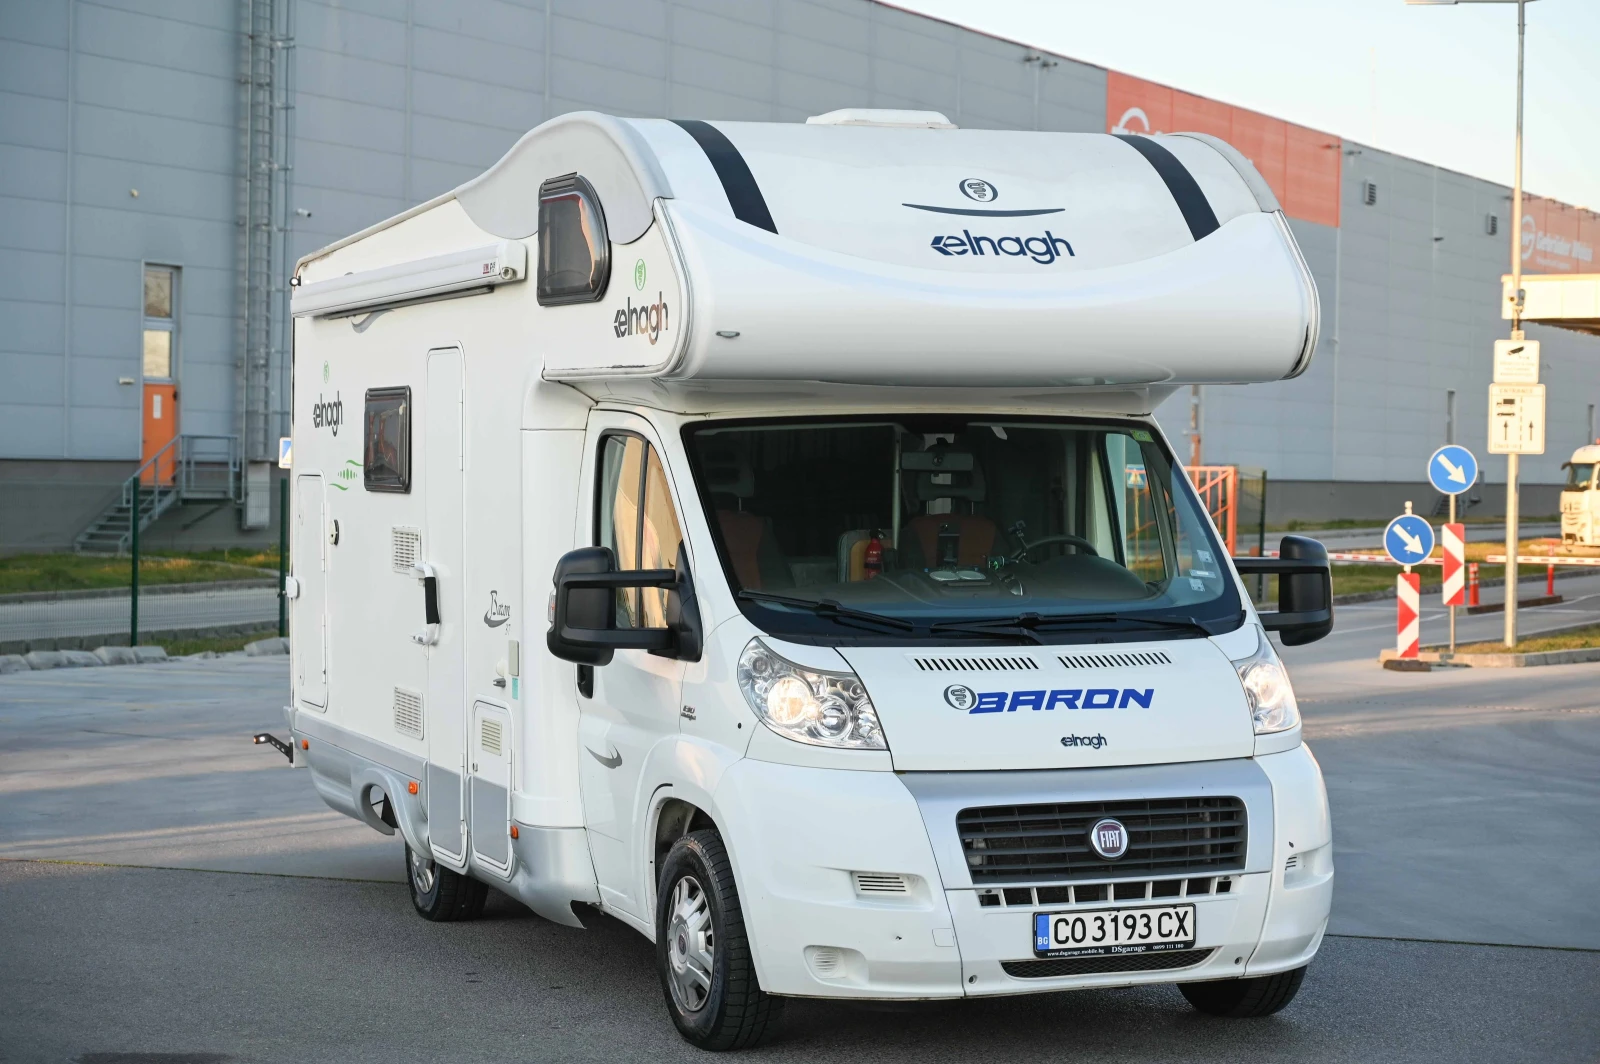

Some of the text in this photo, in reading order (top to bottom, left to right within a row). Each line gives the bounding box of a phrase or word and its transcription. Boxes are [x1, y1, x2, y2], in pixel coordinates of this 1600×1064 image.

[931, 229, 1075, 265] elnagh
[613, 291, 668, 345] elnagh
[313, 390, 343, 438] elnagh
[969, 688, 1154, 714] BARON
[1060, 733, 1107, 750] elnagh
[1099, 829, 1120, 848] FIAT
[1092, 913, 1152, 943] 3193
[1157, 910, 1189, 938] CX
[1037, 936, 1049, 946] BG
[1111, 944, 1147, 954] DSgarage
